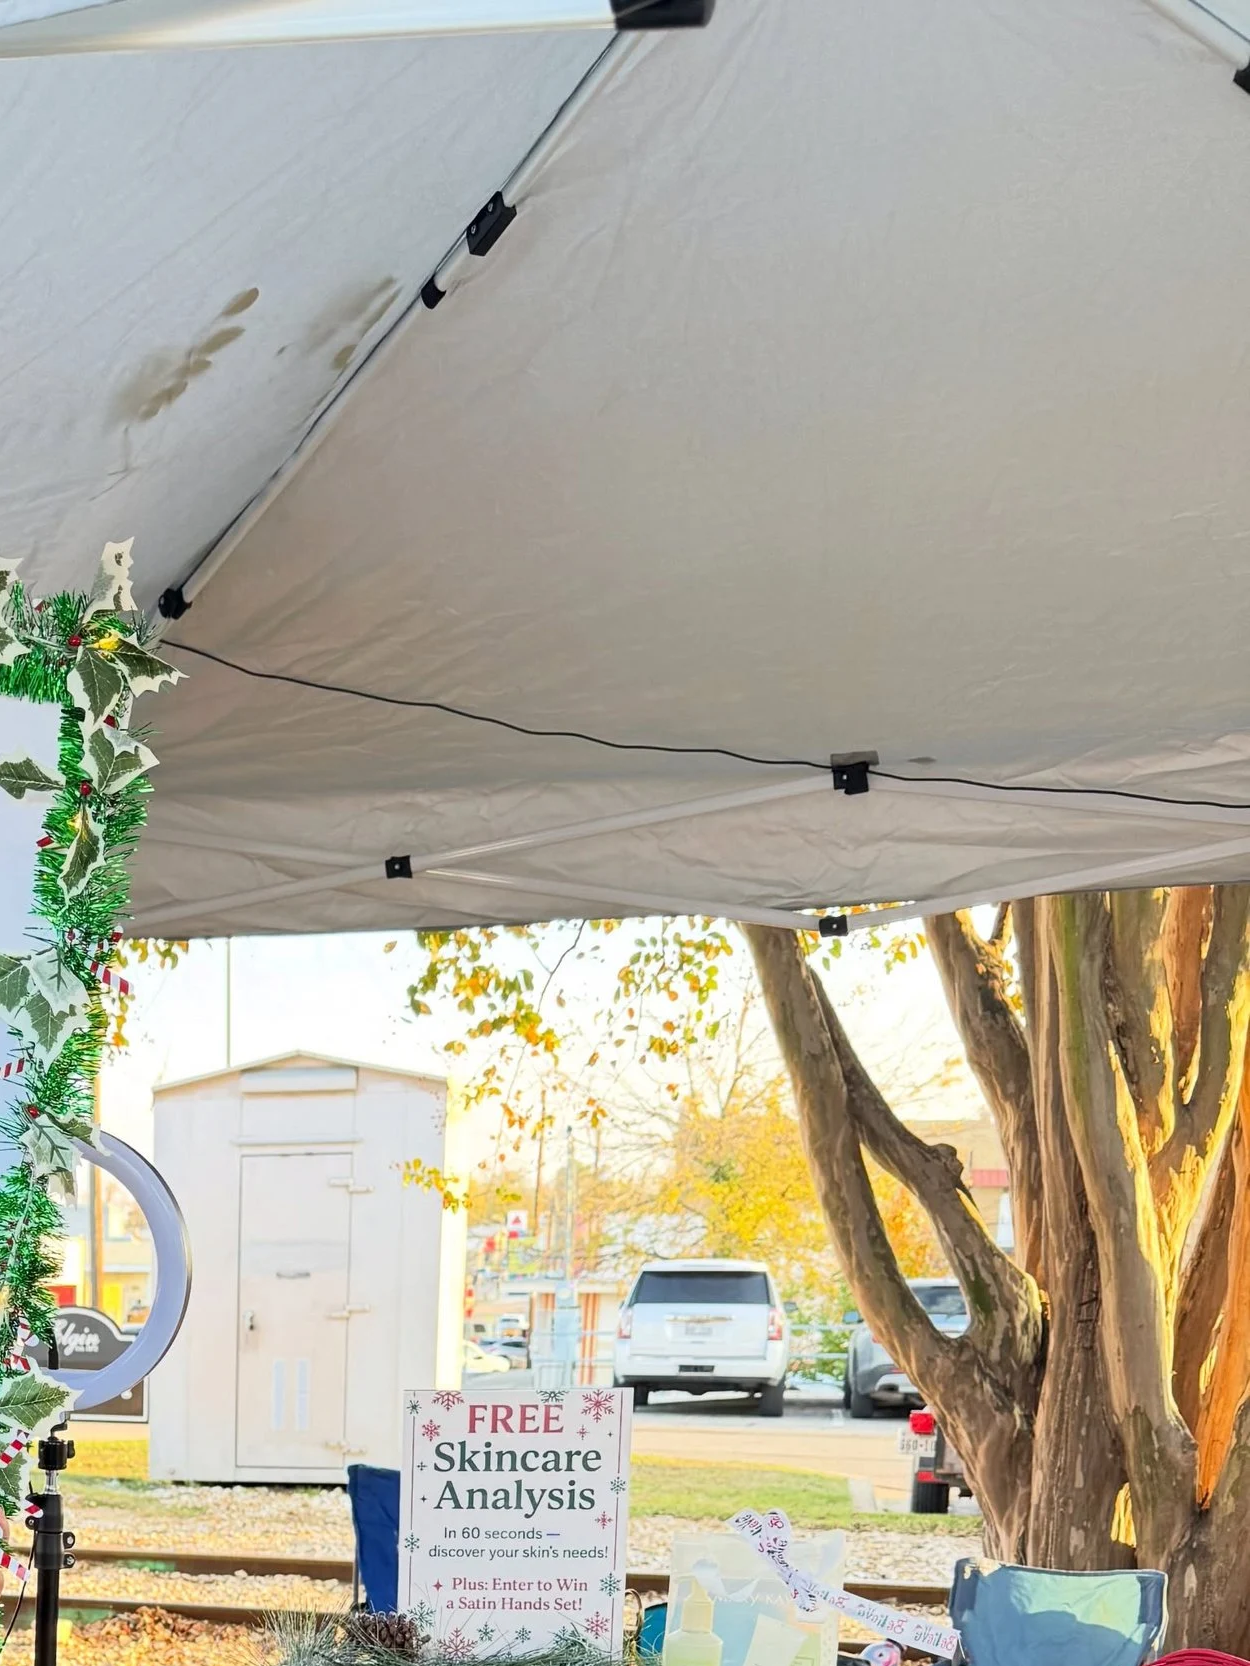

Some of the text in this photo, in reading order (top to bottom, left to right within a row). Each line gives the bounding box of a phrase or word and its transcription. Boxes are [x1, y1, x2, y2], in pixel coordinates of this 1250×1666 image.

[467, 1404, 564, 1434] FREE
[433, 1440, 602, 1473] Skincare
[433, 1479, 596, 1519] Analysis
[444, 1527, 457, 1539] In
[461, 1527, 480, 1540] 60
[484, 1527, 543, 1540] seconds
[428, 1545, 609, 1561] discover your skin's needs!
[452, 1577, 588, 1592] Plus: Enter to Win
[446, 1597, 583, 1611] a Satin Hands Set!
